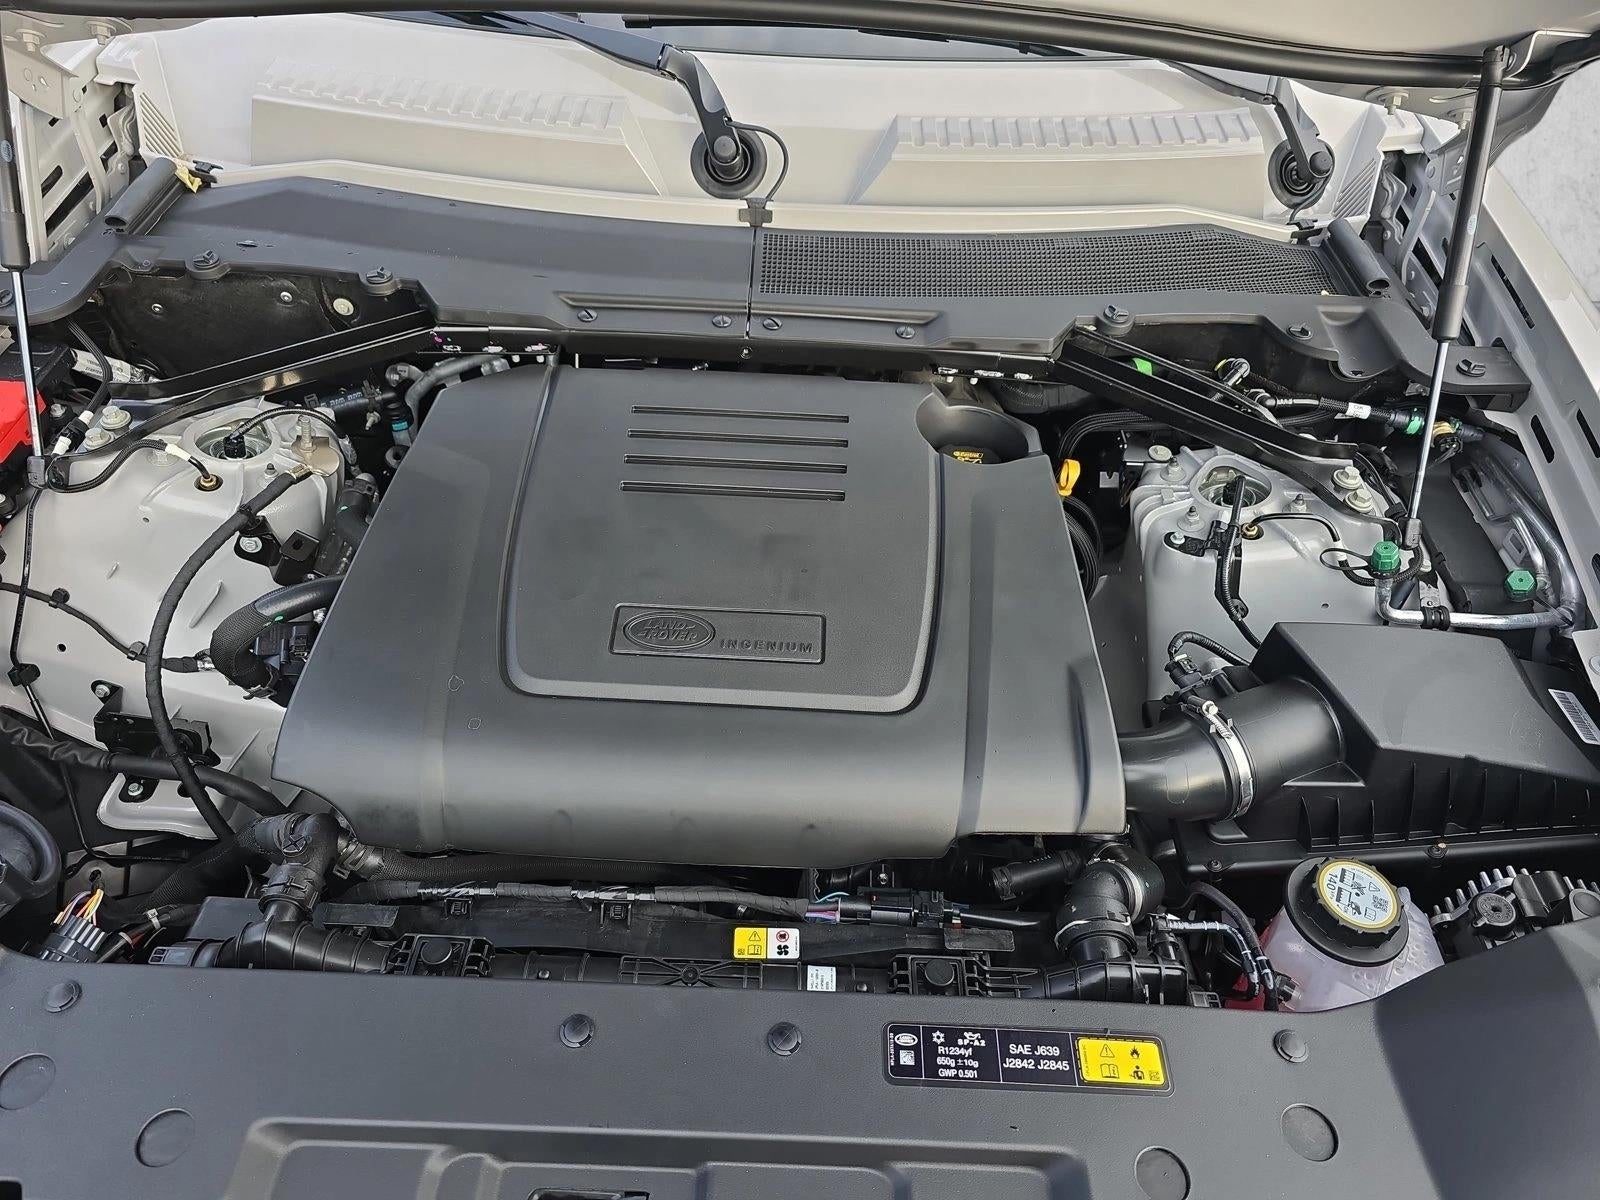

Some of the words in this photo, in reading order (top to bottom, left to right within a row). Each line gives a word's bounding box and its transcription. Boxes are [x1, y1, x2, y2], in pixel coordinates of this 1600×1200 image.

[643, 618, 689, 629] LAND
[645, 630, 699, 642] ROVER
[720, 638, 814, 654] INGENIUM
[1326, 873, 1338, 891] 140
[937, 1045, 973, 1057] R1234yf
[1009, 1043, 1033, 1055] SAE
[1034, 1045, 1060, 1057] J639
[936, 1056, 956, 1068] 650g
[957, 1057, 979, 1068] ±10g
[1002, 1057, 1036, 1069] J2842
[1037, 1059, 1070, 1071] J2845
[938, 1068, 957, 1077] GWP
[958, 1069, 978, 1078] 0.501
